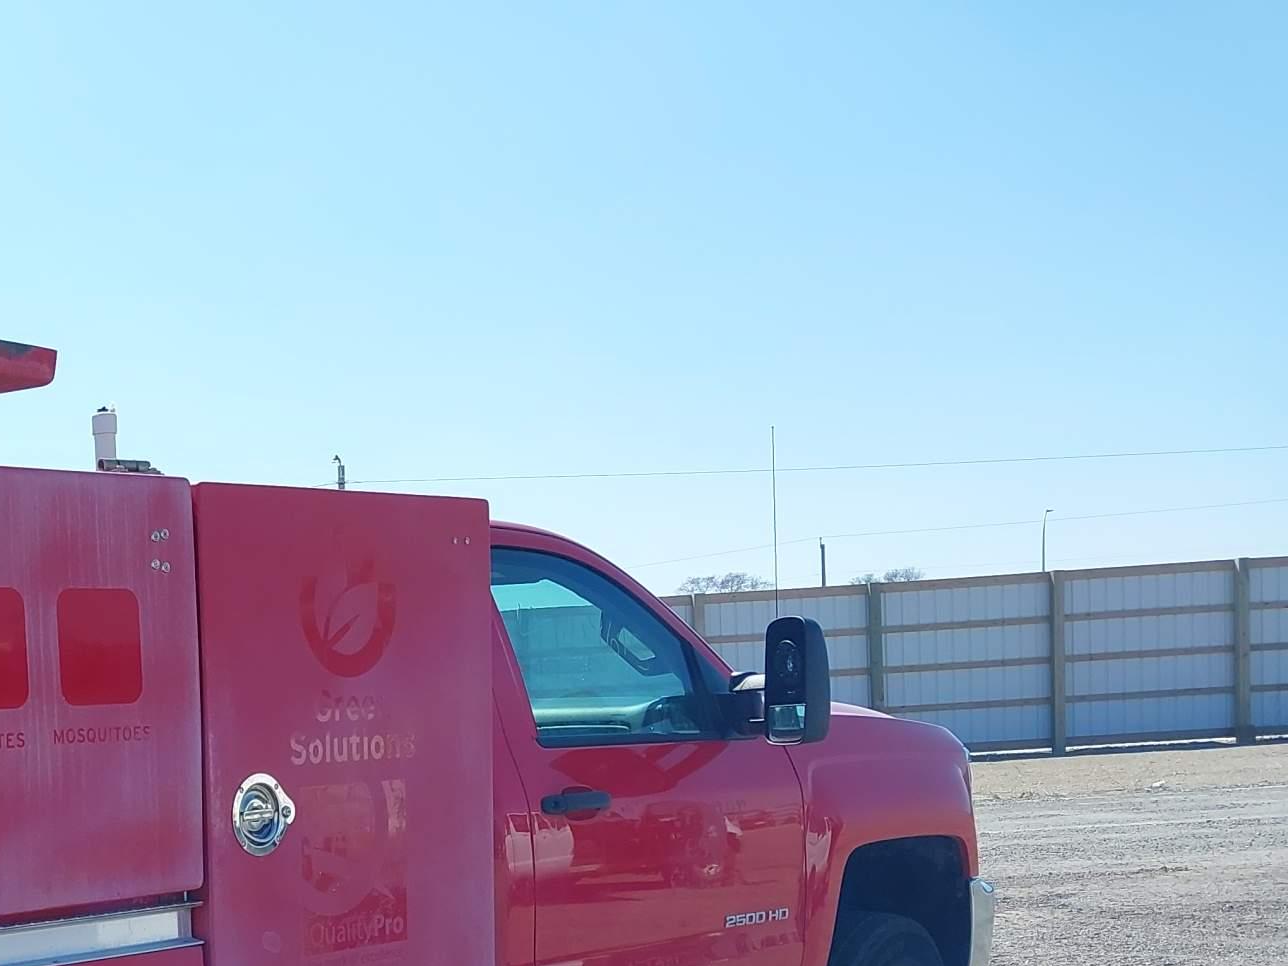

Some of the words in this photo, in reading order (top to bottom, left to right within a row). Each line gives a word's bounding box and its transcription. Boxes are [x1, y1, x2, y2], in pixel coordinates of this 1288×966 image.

[53, 725, 152, 745] MOSQUITOES
[290, 729, 416, 766] Solutions
[310, 912, 404, 946] QualityPro
[724, 912, 766, 929] 2500
[768, 907, 789, 921] HD
